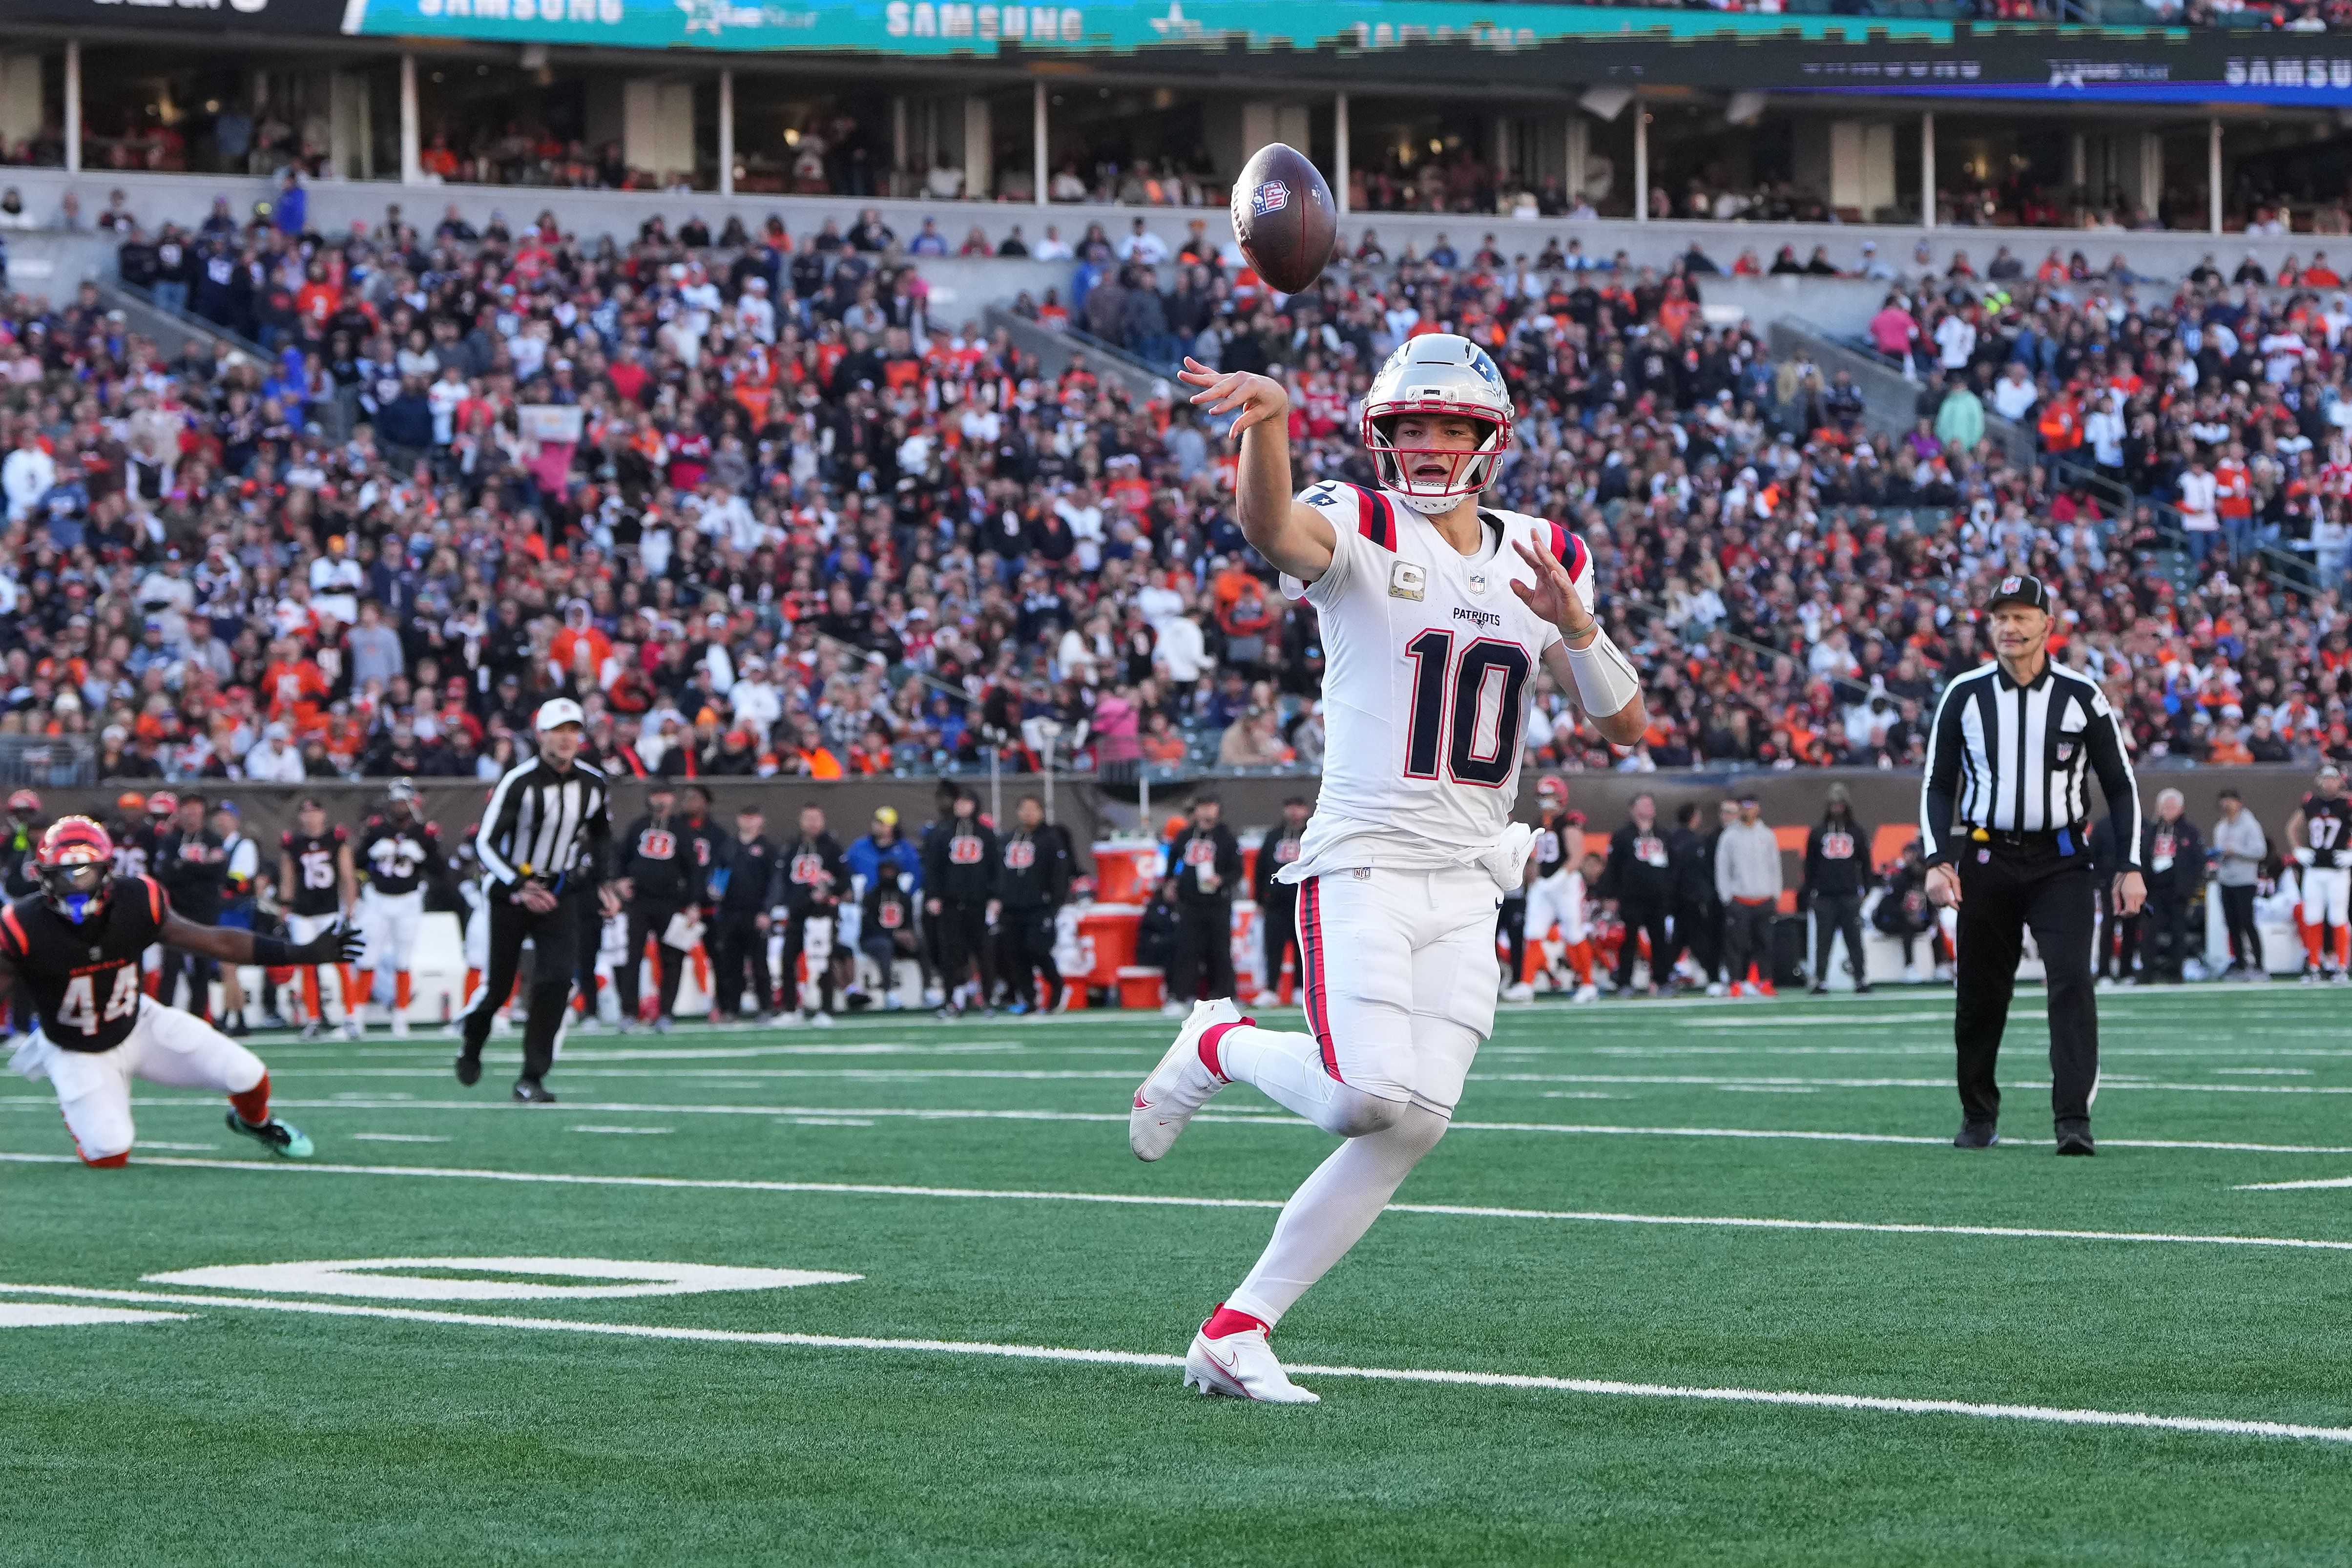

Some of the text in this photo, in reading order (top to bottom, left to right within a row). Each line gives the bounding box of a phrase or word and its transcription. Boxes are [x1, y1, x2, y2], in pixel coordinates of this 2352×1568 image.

[885, 1, 1082, 41] SAMSUNG
[1265, 183, 1284, 209] NFL
[1394, 564, 1424, 591] C
[1471, 583, 1484, 592] NFL
[1453, 607, 1500, 627] PATRIOTS
[1404, 628, 1532, 789] 10
[299, 851, 335, 890] 15
[56, 961, 139, 1037] 44
